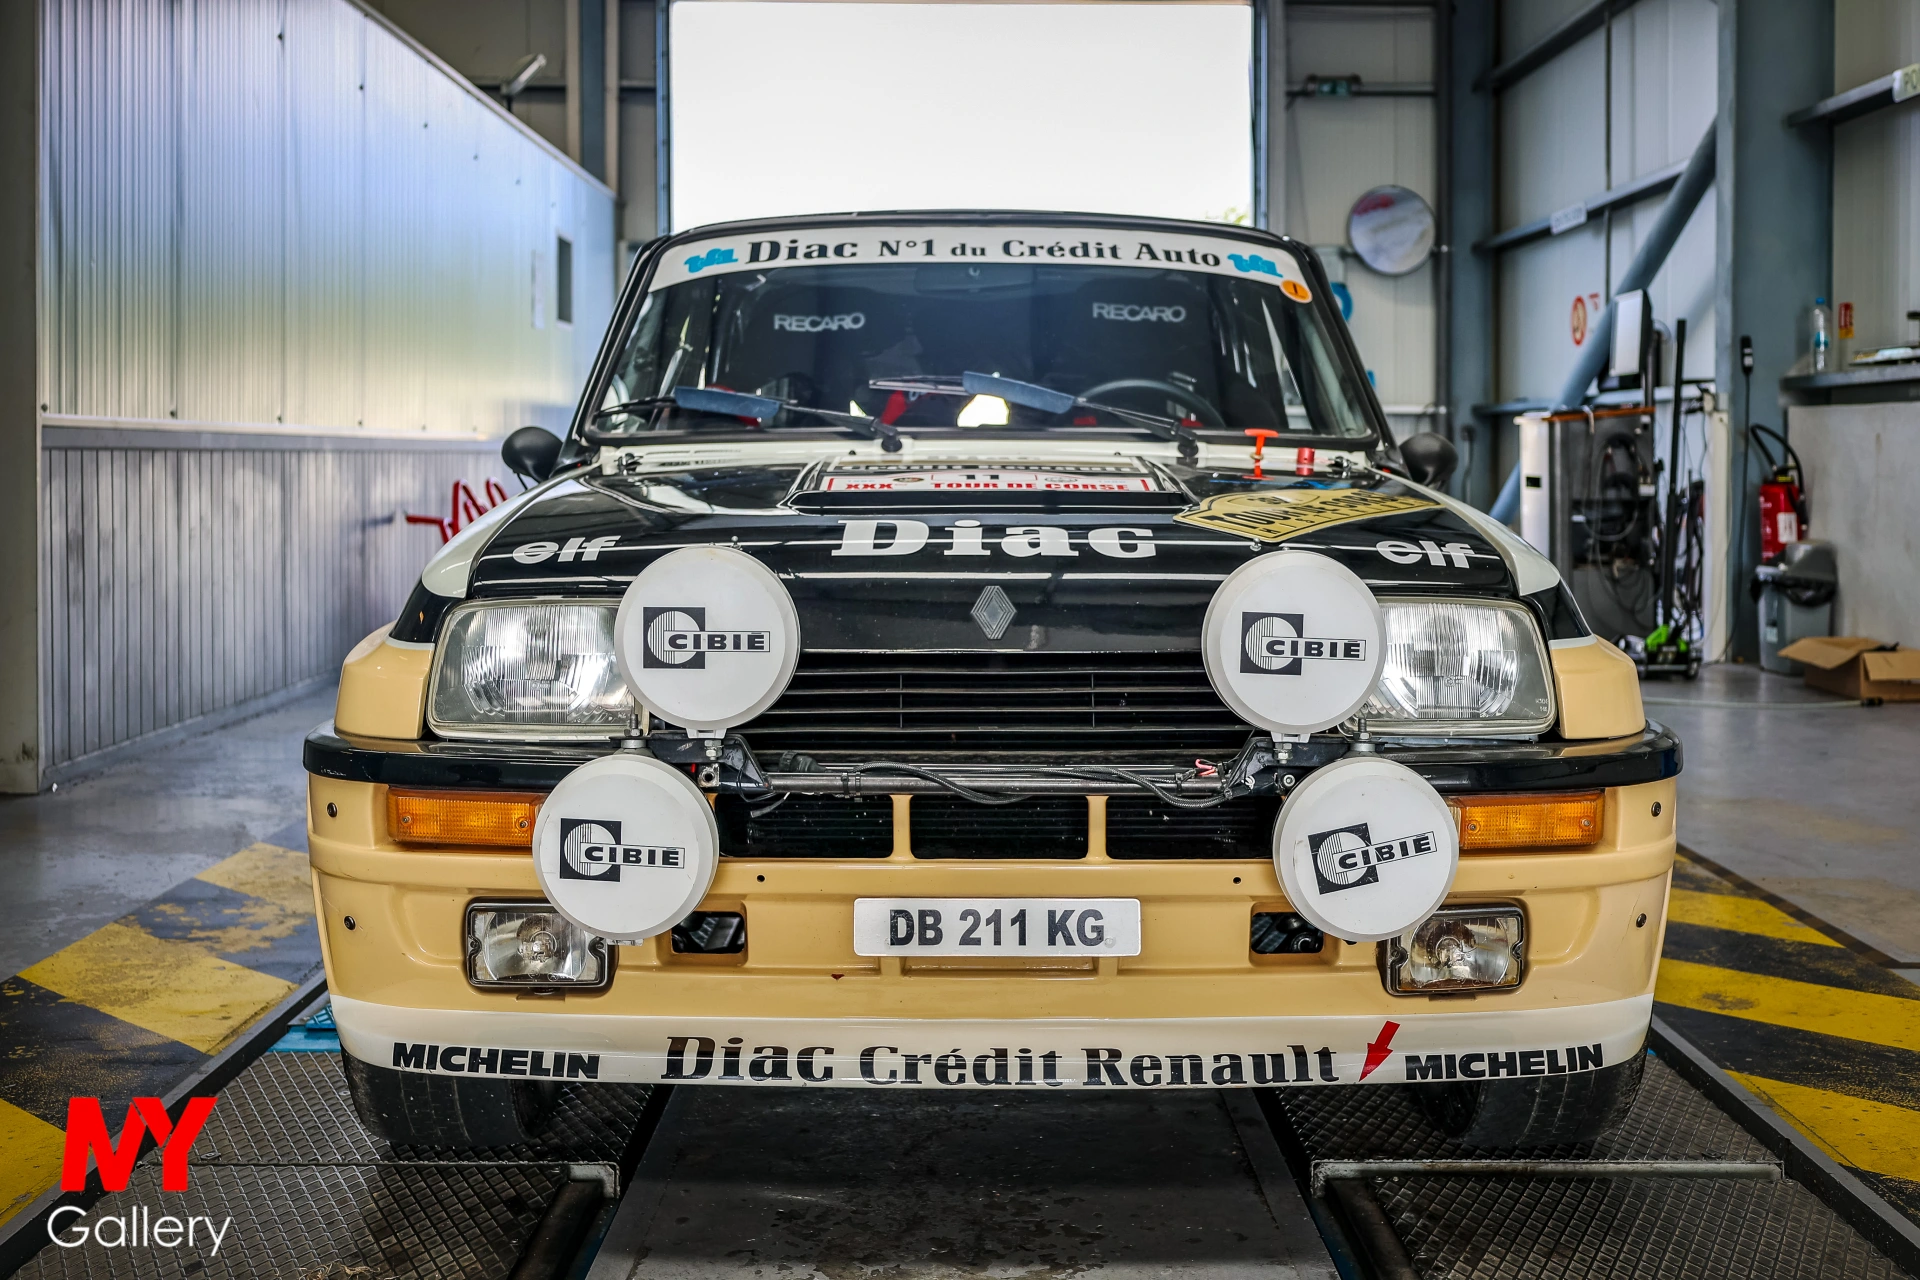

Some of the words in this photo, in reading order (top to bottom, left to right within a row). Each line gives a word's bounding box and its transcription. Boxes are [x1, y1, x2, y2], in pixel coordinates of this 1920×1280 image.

[745, 239, 858, 265] Diac
[950, 241, 986, 257] du
[1003, 239, 1123, 260] Crédit
[1135, 242, 1220, 267] Auto
[773, 312, 866, 332] RECARO
[1093, 302, 1186, 323] RECARO
[932, 482, 999, 490] TOUR
[1006, 482, 1037, 490] DE
[1045, 483, 1130, 491] CORSE
[512, 535, 622, 565] elf
[831, 519, 1157, 559] Diac
[1375, 540, 1477, 569] elf
[889, 909, 944, 947] DB
[958, 908, 1027, 947] 211
[1047, 909, 1105, 947] KG
[392, 1041, 601, 1079] MICHELIN
[660, 1034, 835, 1082] Diac
[859, 1045, 1064, 1087] Crédit
[1081, 1044, 1340, 1087] Renault
[1405, 1042, 1604, 1081] MICHELIN
